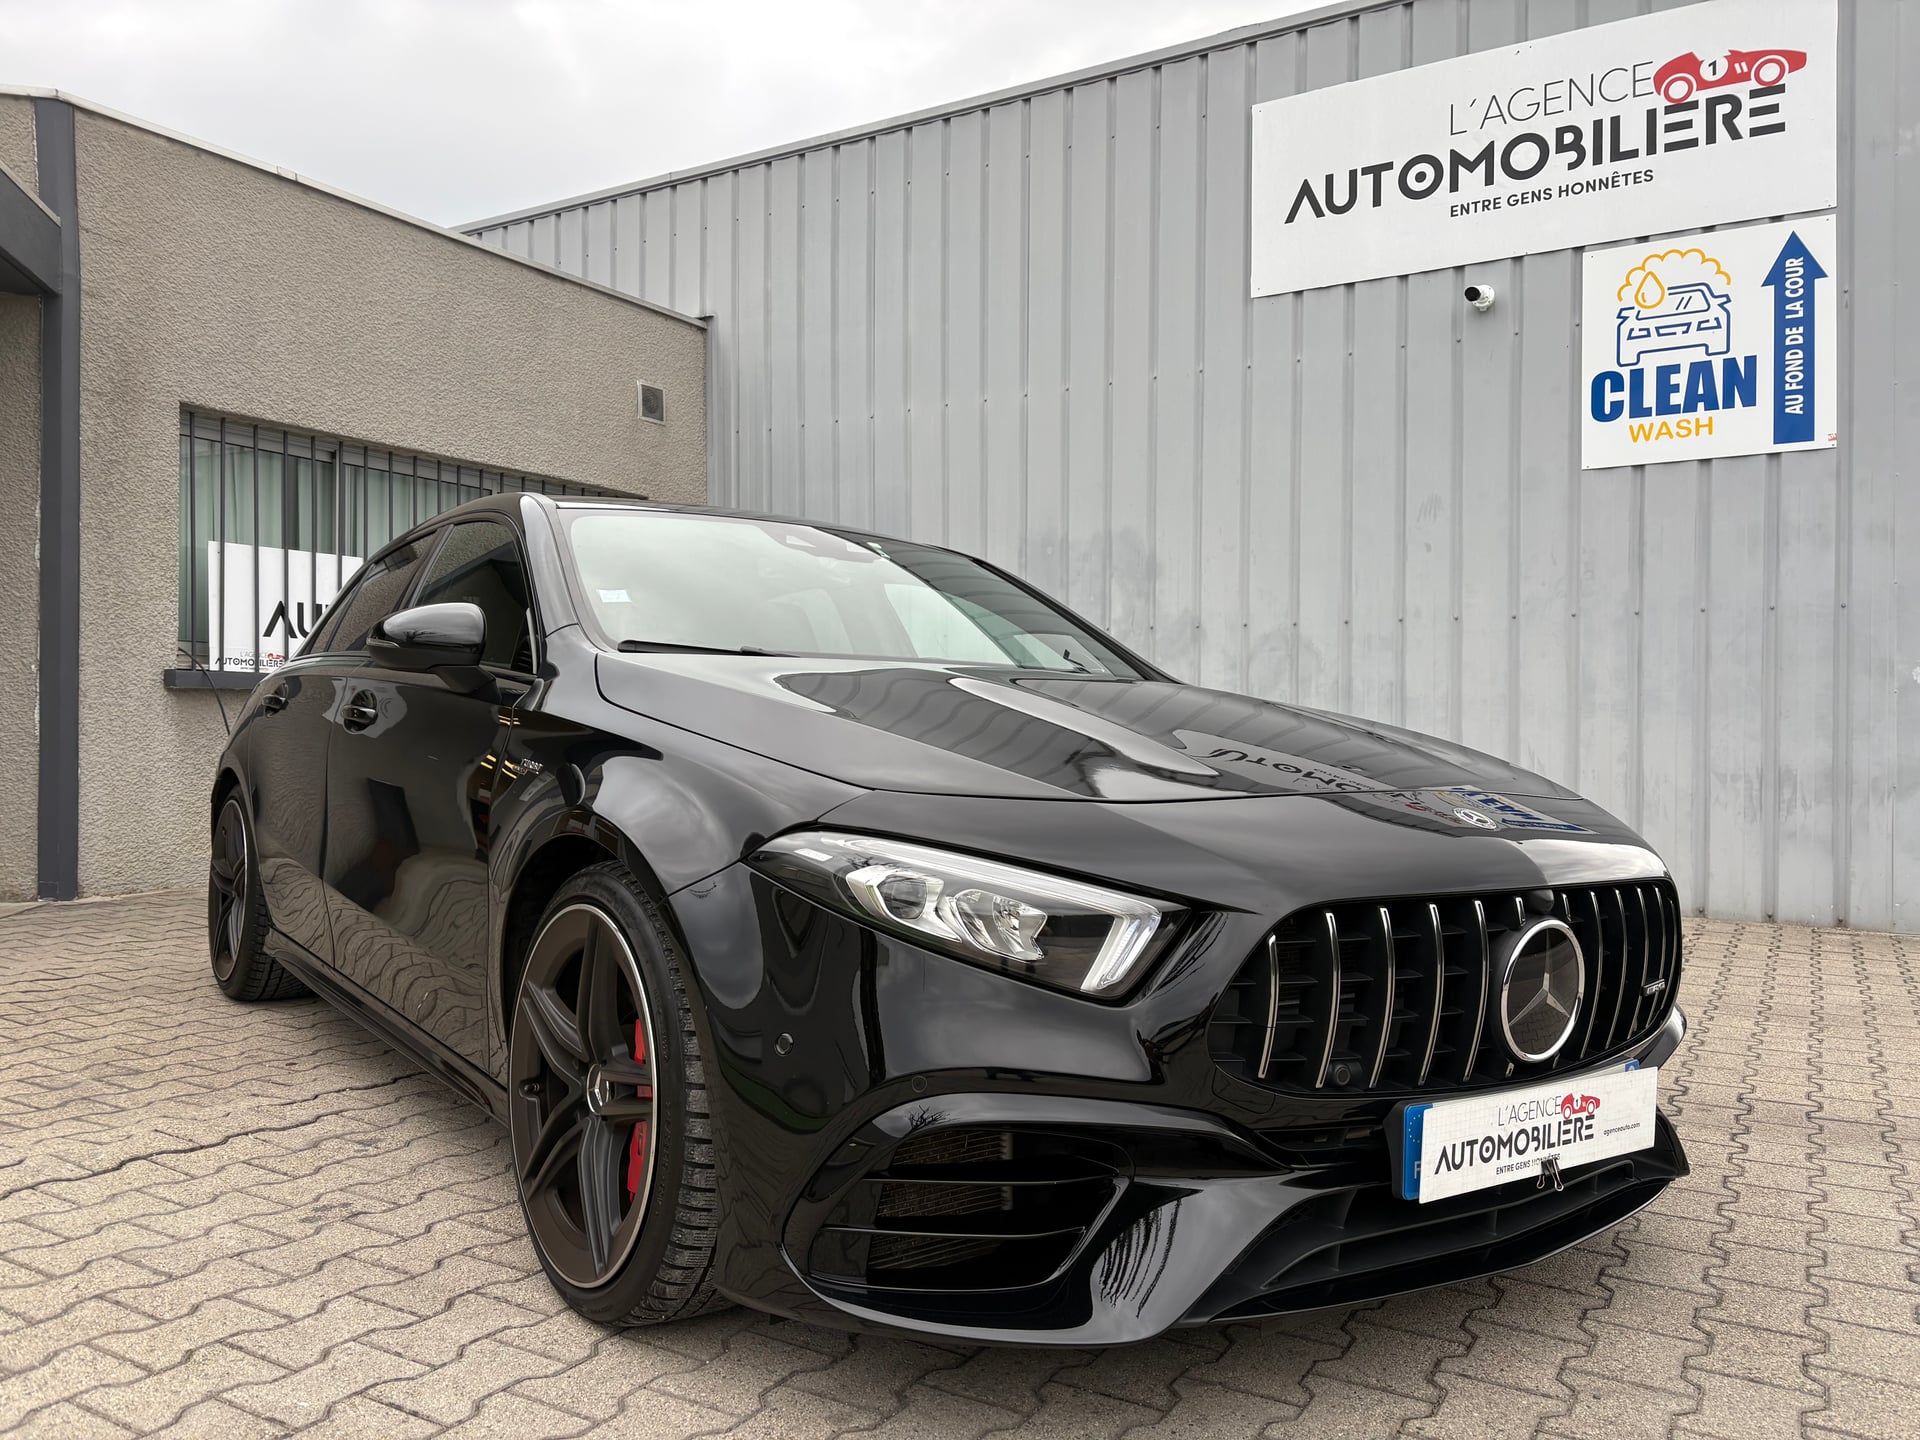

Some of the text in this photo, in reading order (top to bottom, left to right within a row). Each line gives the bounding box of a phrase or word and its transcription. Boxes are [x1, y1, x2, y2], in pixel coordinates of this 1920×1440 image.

[1449, 61, 1656, 136] L'AGENCE
[1449, 168, 1655, 218] ENTRE GENS HONNÊTES
[1785, 257, 1804, 415] AU FOND DE LA COUR
[1591, 354, 1757, 423] CLEAN
[1628, 416, 1714, 443] WASH
[262, 600, 329, 639] AU
[1497, 1095, 1562, 1127] L'AGENCE
[1496, 1163, 1515, 1175] ENTRE
[1515, 1160, 1531, 1171] GENS
